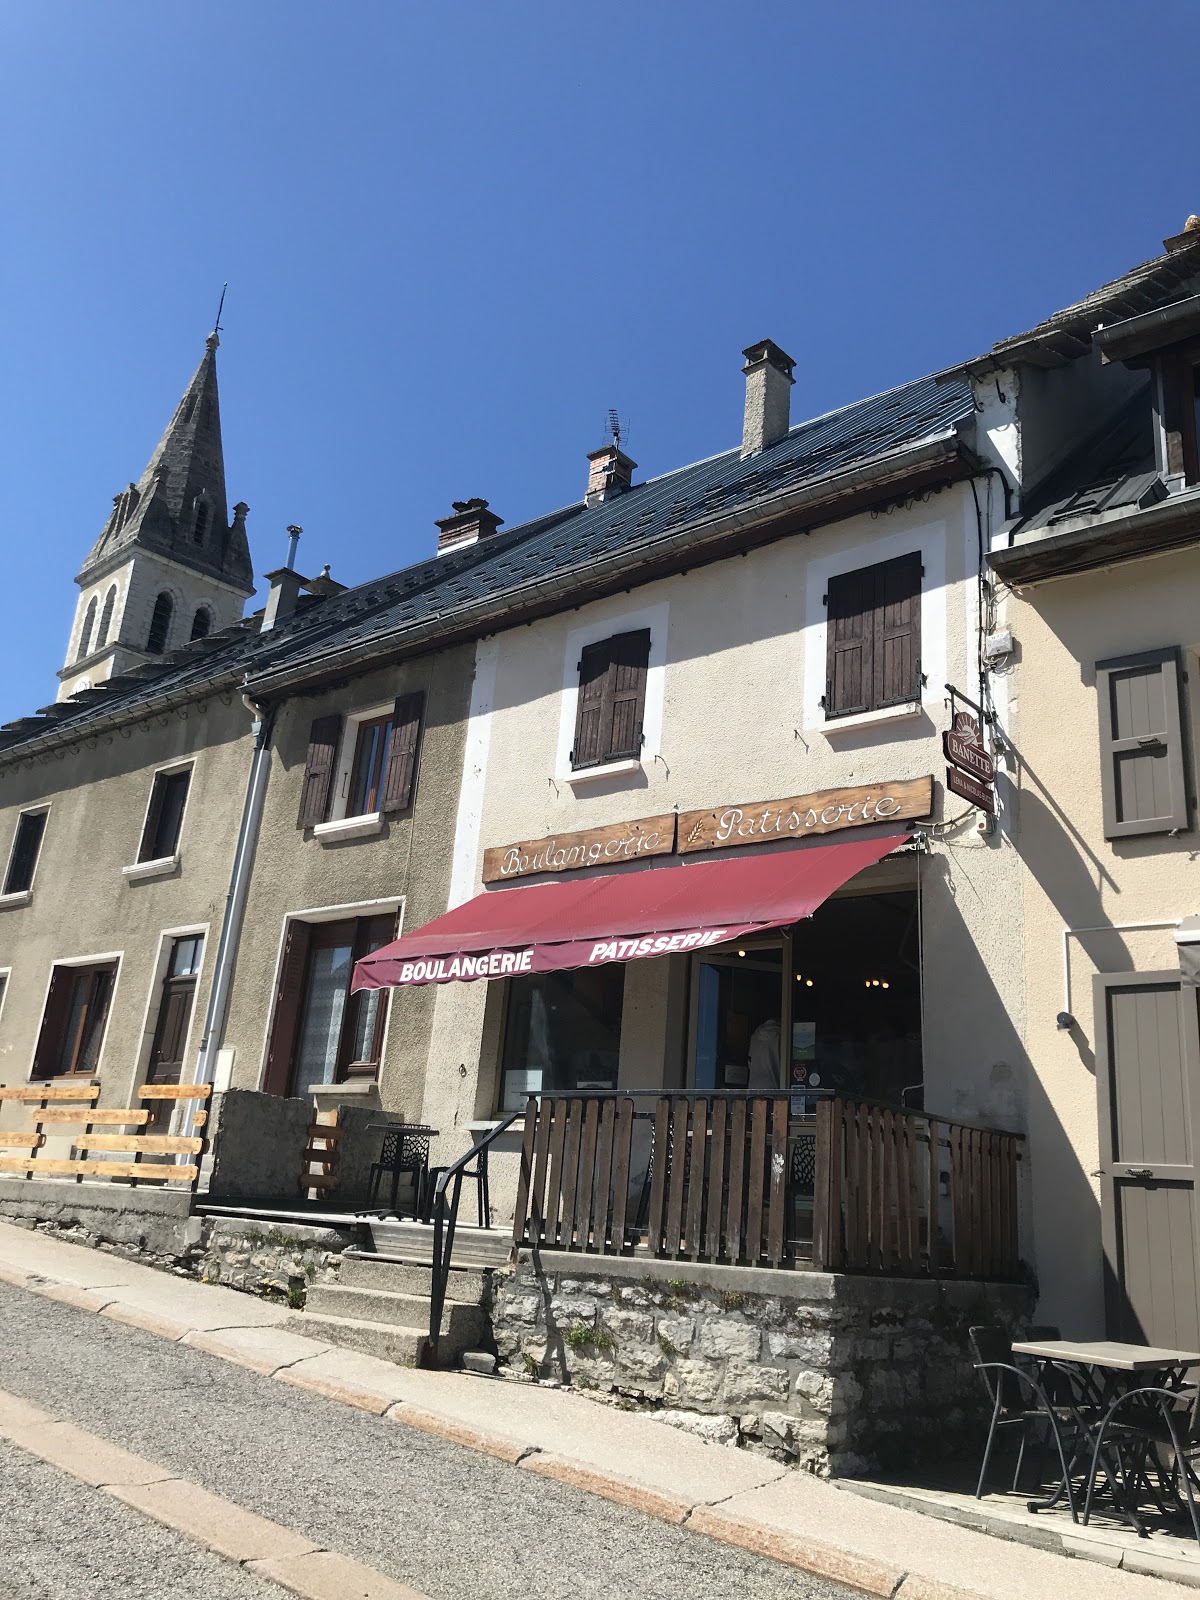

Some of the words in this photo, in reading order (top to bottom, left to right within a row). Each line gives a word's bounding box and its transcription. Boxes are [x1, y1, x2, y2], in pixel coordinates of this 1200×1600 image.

[952, 738, 990, 773] BANETTE
[500, 830, 659, 875] Boulangerie
[716, 796, 901, 841] Patisserie
[399, 950, 534, 982] BOULANGERIE
[588, 930, 727, 962] PATISSERIE
